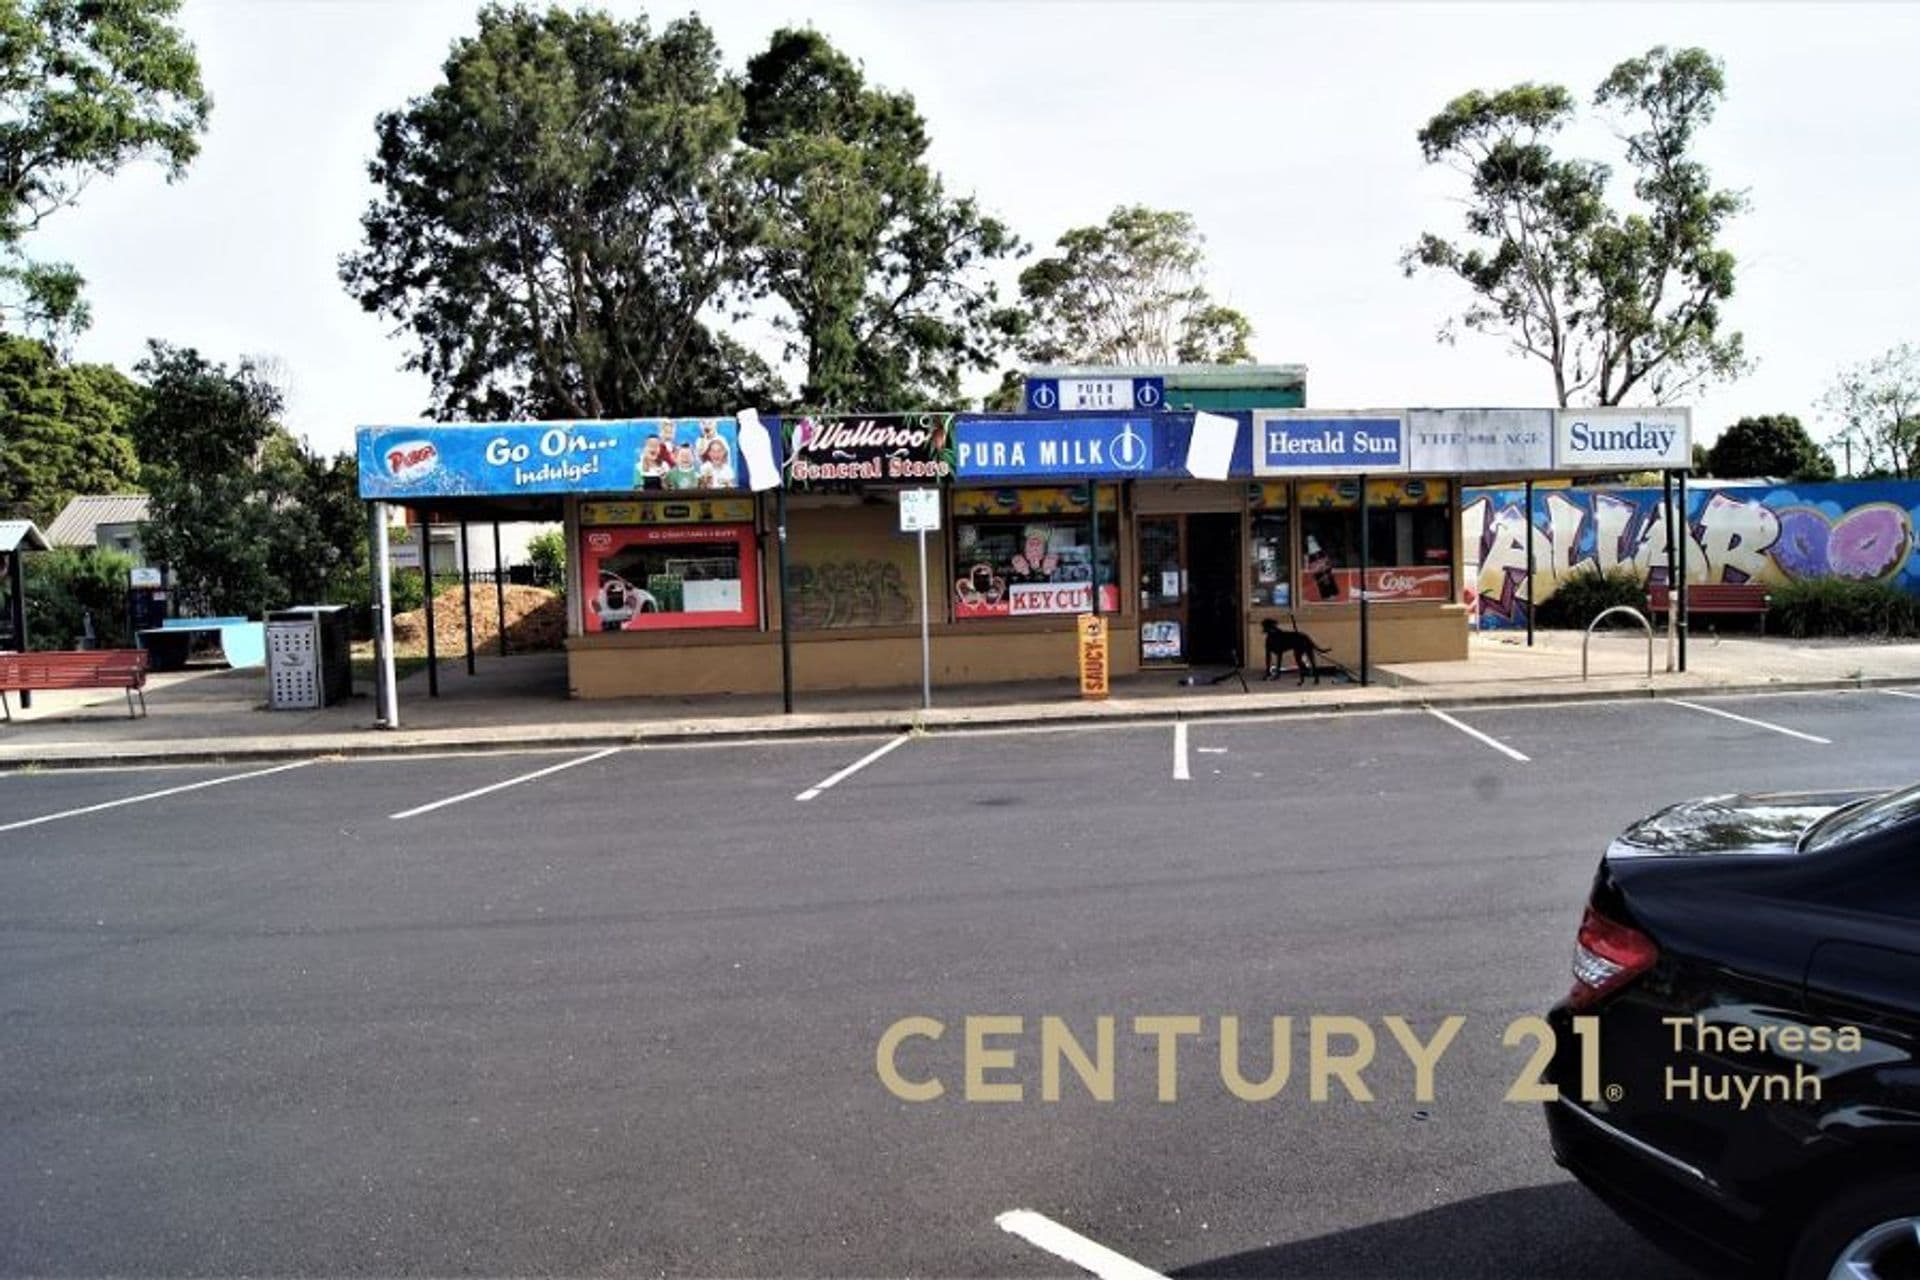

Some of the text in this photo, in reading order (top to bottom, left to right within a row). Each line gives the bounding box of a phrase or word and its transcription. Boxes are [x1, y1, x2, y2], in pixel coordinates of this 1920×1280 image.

[809, 421, 931, 451] Wallaroo
[1269, 431, 1397, 454] Herald Sun
[1417, 432, 1462, 445] THE
[1570, 421, 1674, 456] Sunday
[486, 437, 529, 466] Go
[958, 440, 1104, 467] PURA MILK
[515, 454, 599, 486] Indulge!
[791, 457, 949, 480] General Store
[1378, 571, 1417, 591] Coke
[1012, 591, 1054, 610] KEY
[1084, 642, 1105, 691] SAUCY
